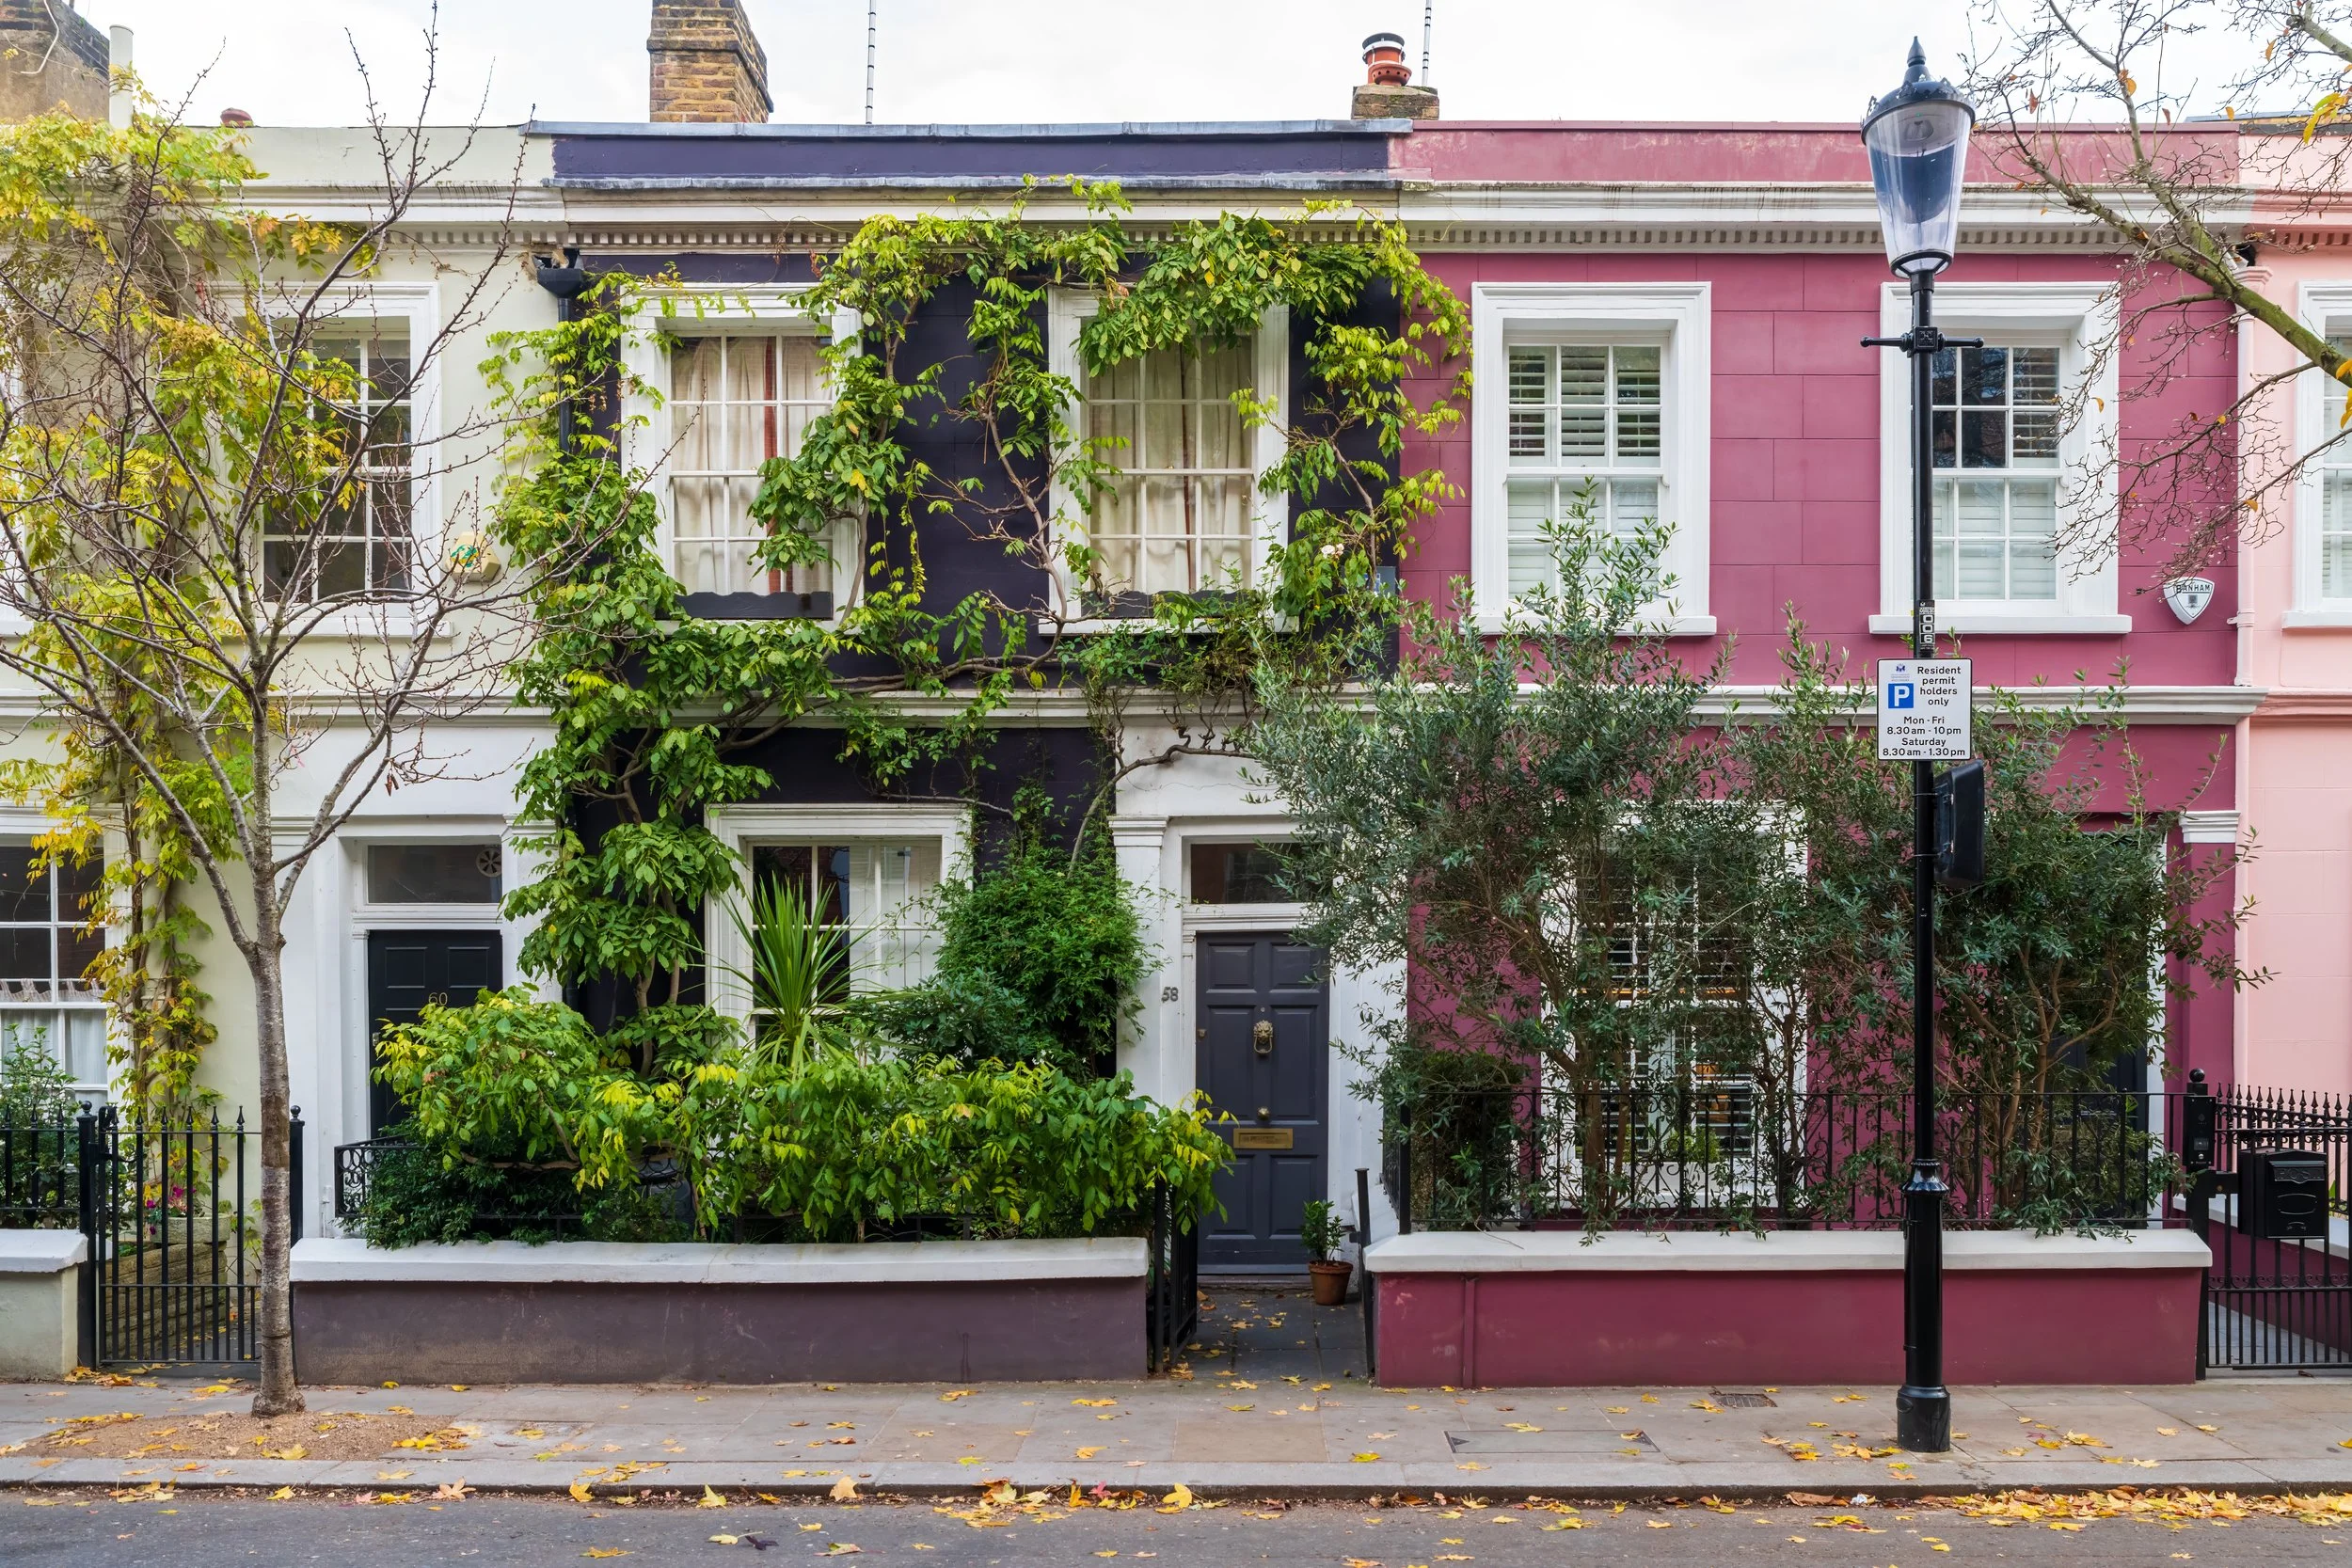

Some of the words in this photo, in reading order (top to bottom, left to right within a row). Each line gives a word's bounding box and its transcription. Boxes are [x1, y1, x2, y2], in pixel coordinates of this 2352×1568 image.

[2176, 584, 2210, 594] BANHAM
[1917, 666, 1962, 674] Resident
[1922, 676, 1955, 686] permit
[1894, 685, 1910, 706] P
[1919, 687, 1958, 695] holders
[1928, 697, 1949, 706] only
[1903, 716, 1925, 724] Mon
[1931, 716, 1945, 724] Fri
[1901, 737, 1947, 747] Saturday
[429, 991, 447, 1006] 60
[1161, 986, 1179, 1003] 58
